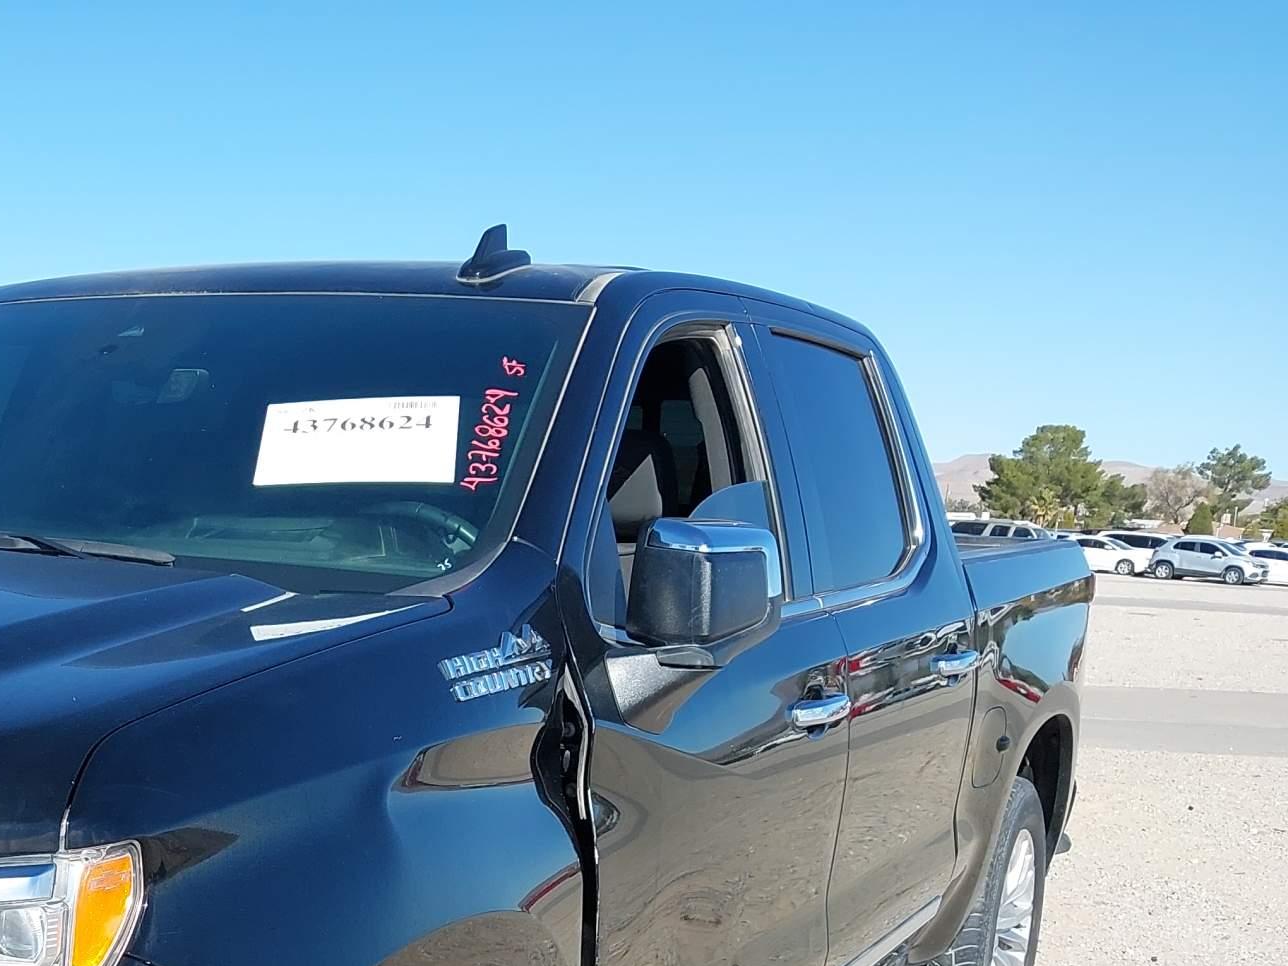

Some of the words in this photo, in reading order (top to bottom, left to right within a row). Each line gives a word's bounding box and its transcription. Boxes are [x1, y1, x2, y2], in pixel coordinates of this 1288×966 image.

[283, 415, 433, 434] 43768624
[459, 388, 519, 491] 43768624
[437, 646, 503, 681] HIGH
[450, 658, 553, 702] COUNTRY
